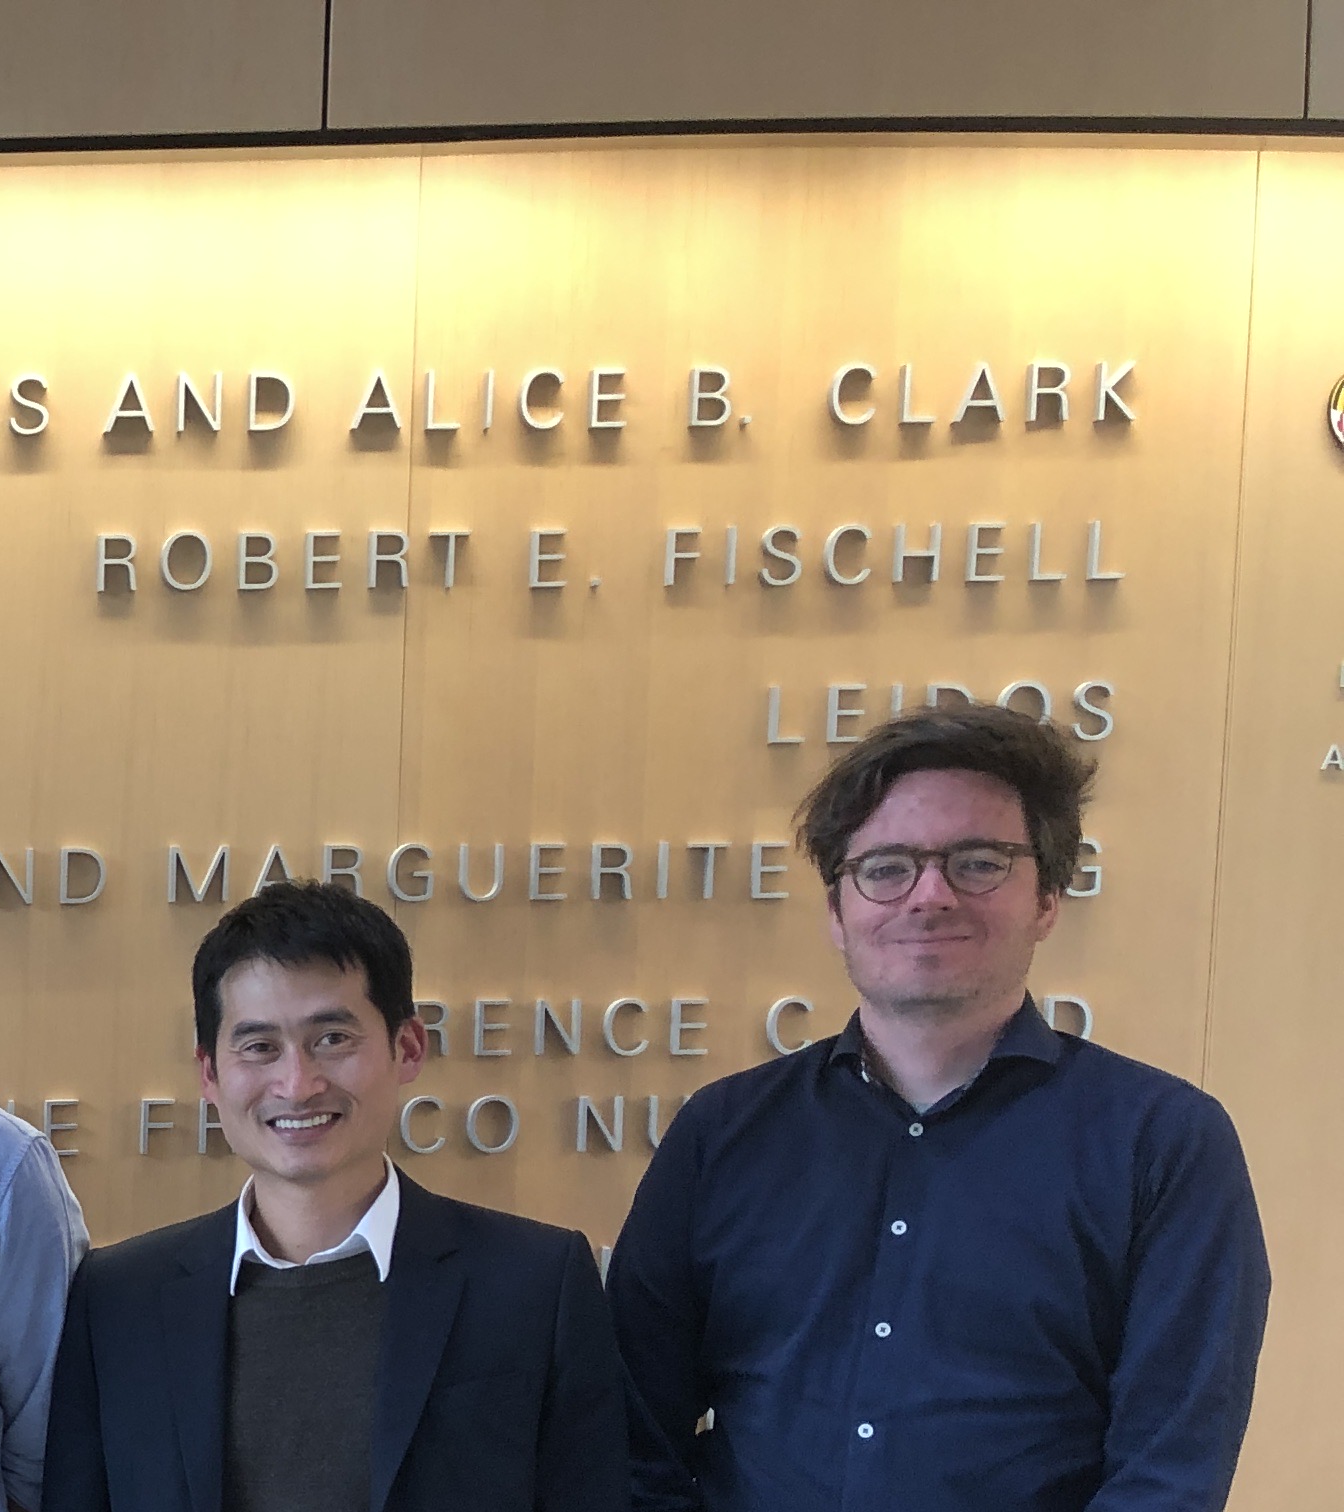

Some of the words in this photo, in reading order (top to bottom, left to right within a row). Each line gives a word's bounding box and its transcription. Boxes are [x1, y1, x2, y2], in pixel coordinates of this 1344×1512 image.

[102, 372, 296, 435] AND
[348, 367, 629, 434] ALICE
[688, 366, 753, 430] B.
[828, 359, 1141, 429] CLARK
[95, 528, 470, 593] ROBERT
[528, 527, 603, 590] E.
[662, 519, 1126, 589] FISCHELL
[167, 841, 792, 904] MARGUERITE
[194, 997, 709, 1058] RENCE
